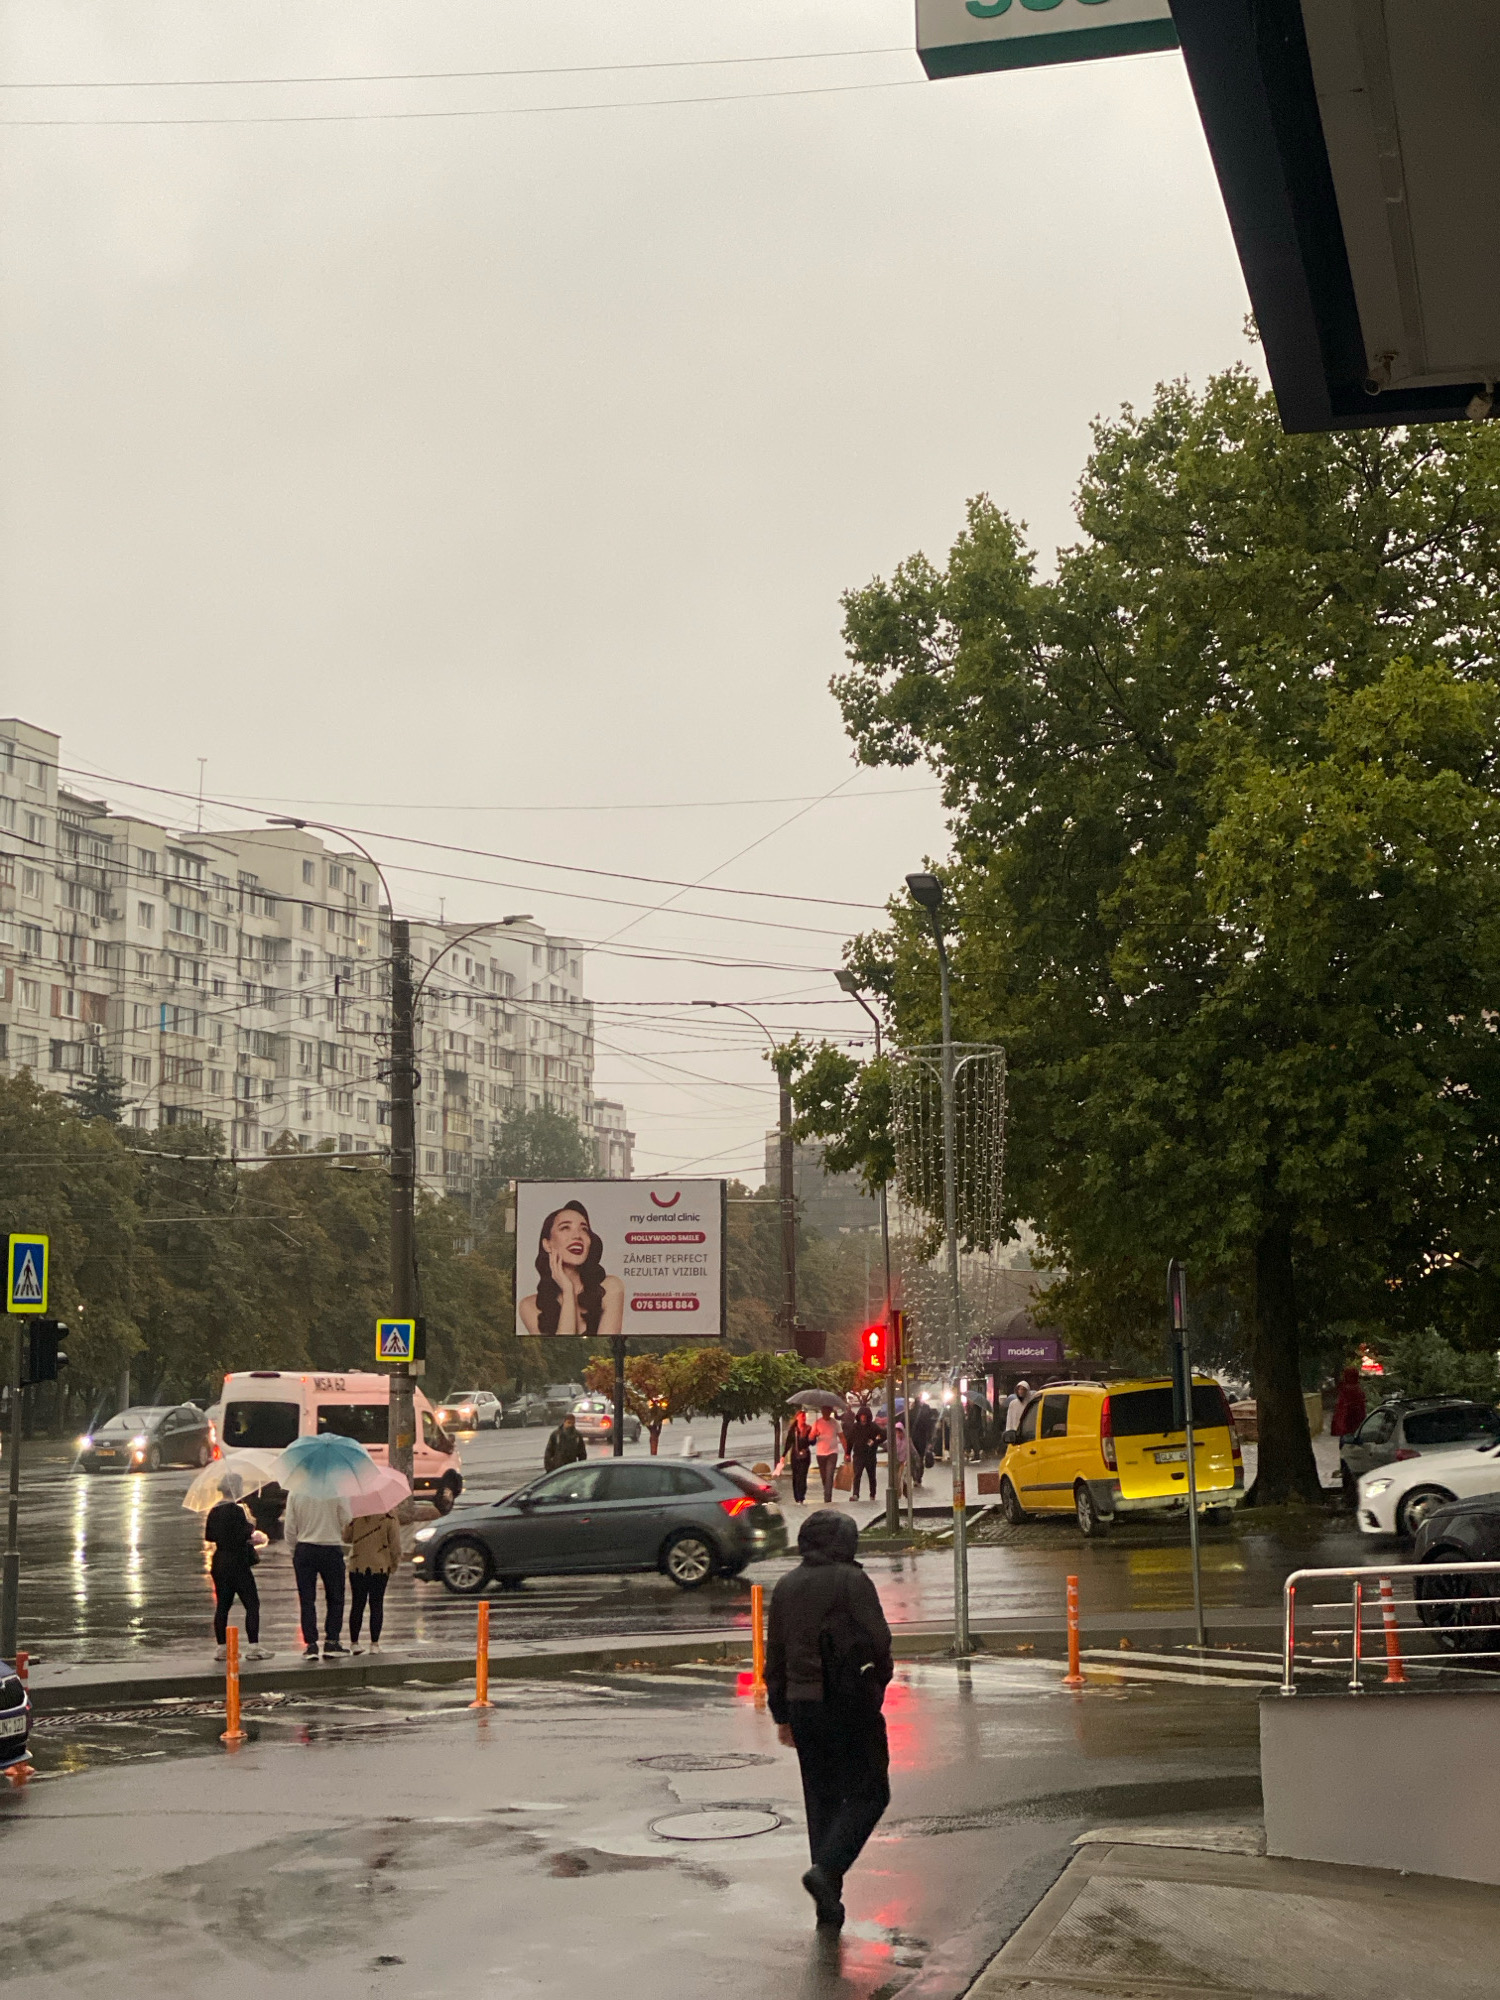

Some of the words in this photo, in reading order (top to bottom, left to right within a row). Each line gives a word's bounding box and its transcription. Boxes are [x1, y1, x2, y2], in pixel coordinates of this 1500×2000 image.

[629, 1214, 645, 1224] my
[646, 1213, 677, 1222] dental
[677, 1212, 701, 1222] clinic
[630, 1234, 677, 1242] HOLLYWOOD
[623, 1252, 663, 1264] ZÂMBET
[665, 1253, 708, 1263] PERFECT
[624, 1267, 670, 1277] REZULTAT
[672, 1267, 708, 1276] VIZIBIL
[636, 1300, 654, 1310] 076
[655, 1300, 674, 1310] 588
[675, 1300, 694, 1310] 884
[1007, 1347, 1045, 1356] moldcell
[335, 1377, 346, 1391] 62
